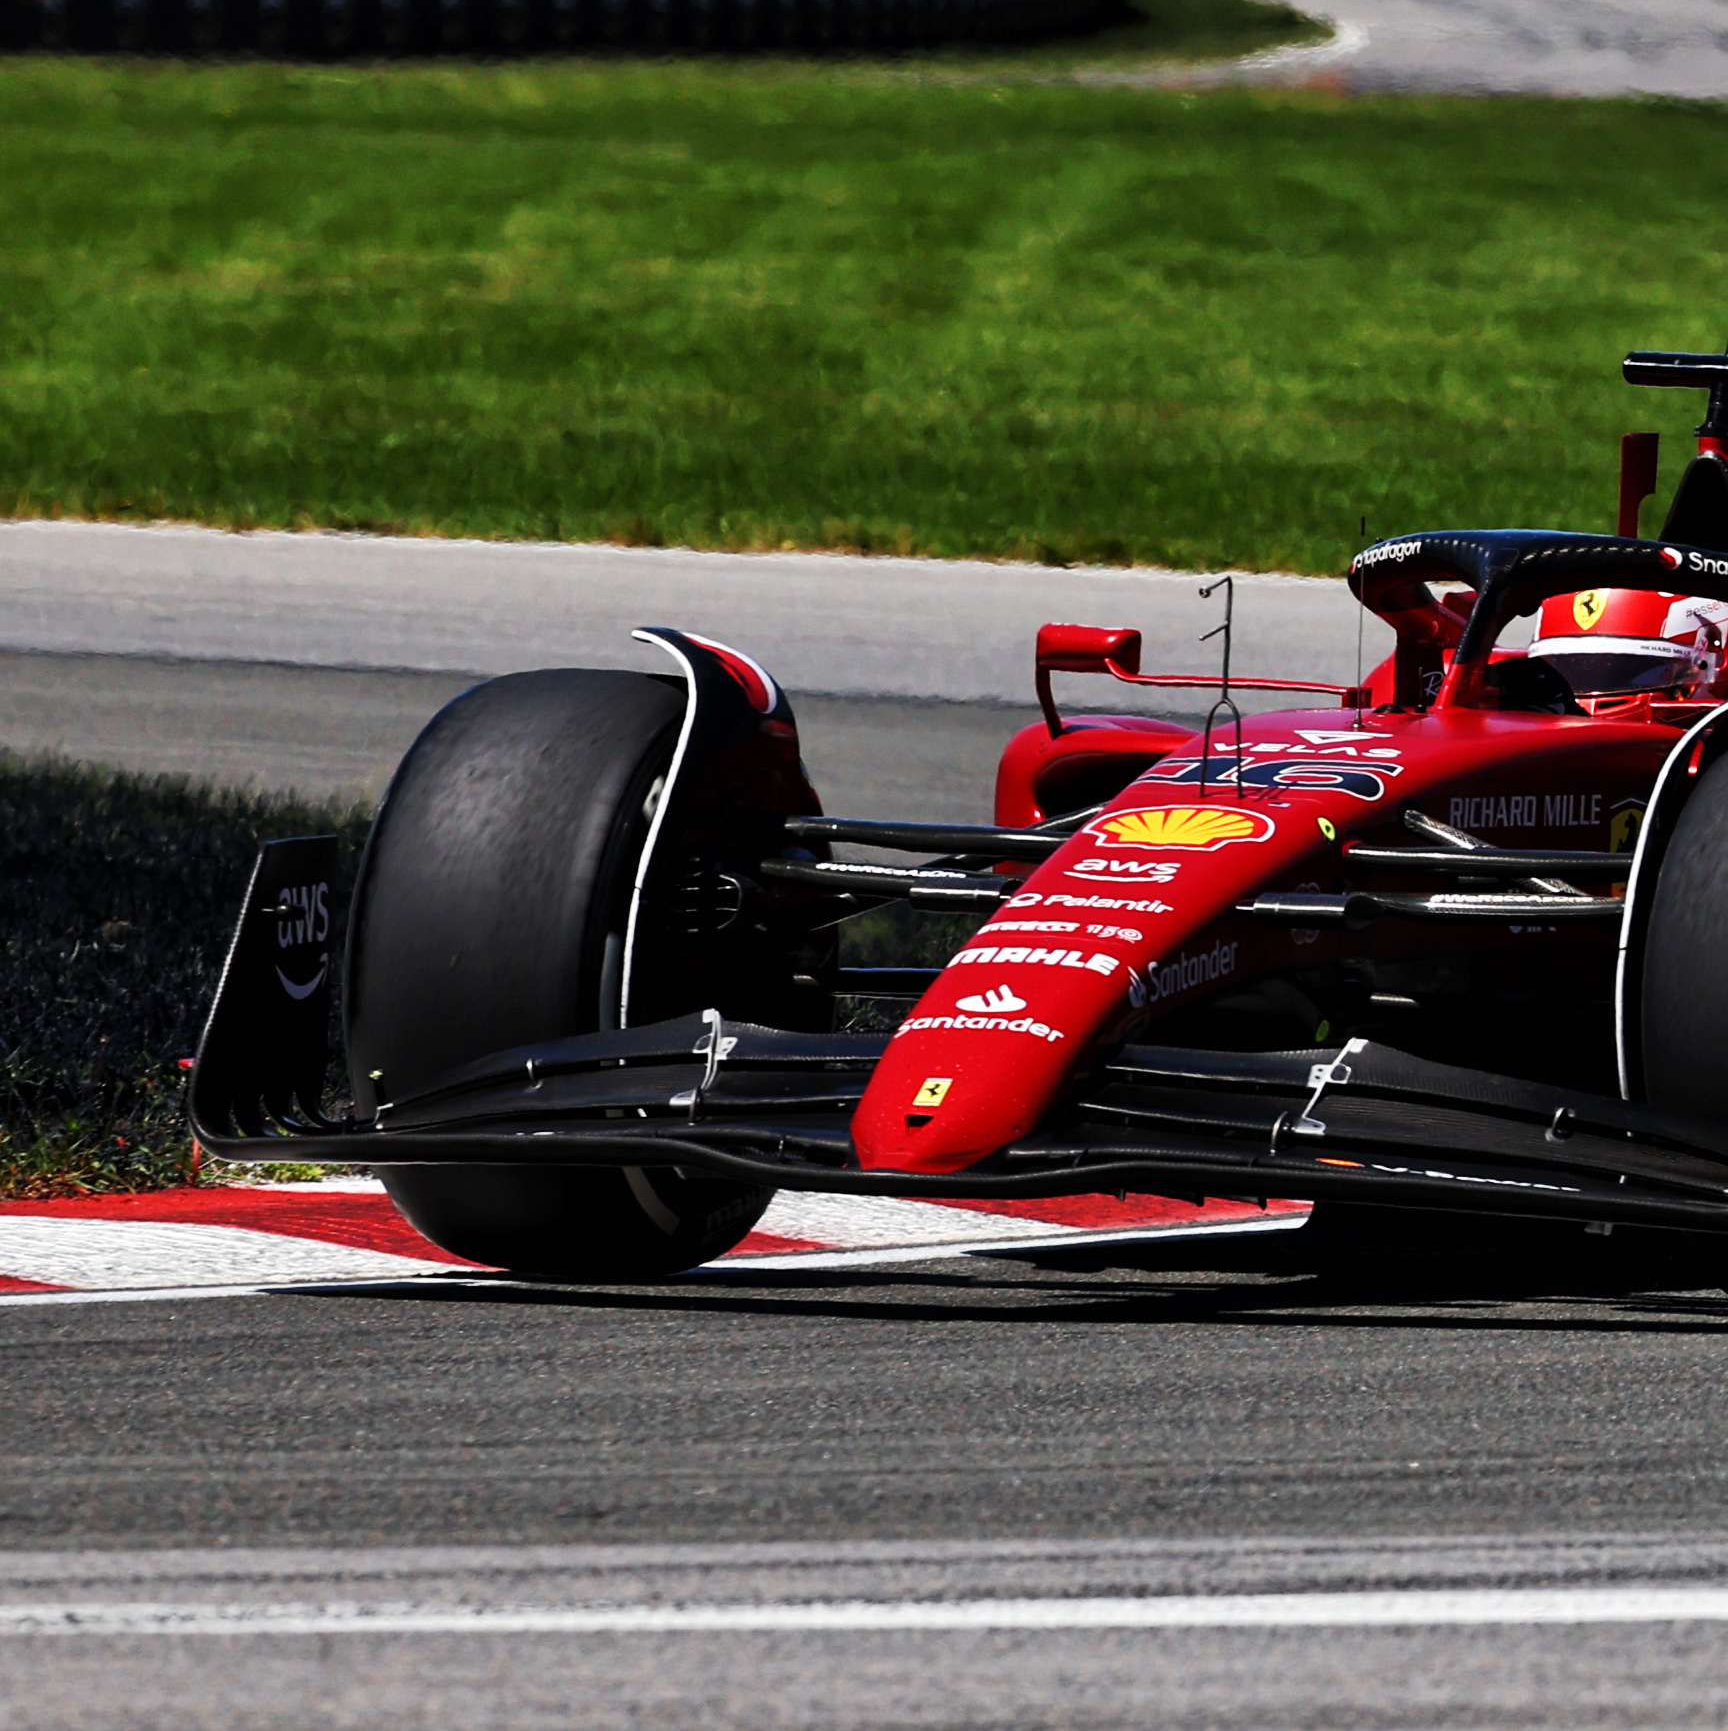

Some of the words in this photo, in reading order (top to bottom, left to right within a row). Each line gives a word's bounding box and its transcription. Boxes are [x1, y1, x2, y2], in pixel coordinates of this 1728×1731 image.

[1131, 756, 1404, 802] 16
[1450, 795, 1537, 828] RICHARD
[1544, 794, 1602, 827] MILLE
[1073, 857, 1182, 875] aws
[1044, 894, 1175, 914] Palantir
[947, 946, 1121, 977] MAHLE
[1149, 941, 1240, 1003] Santander
[893, 1013, 1065, 1043] Santander
